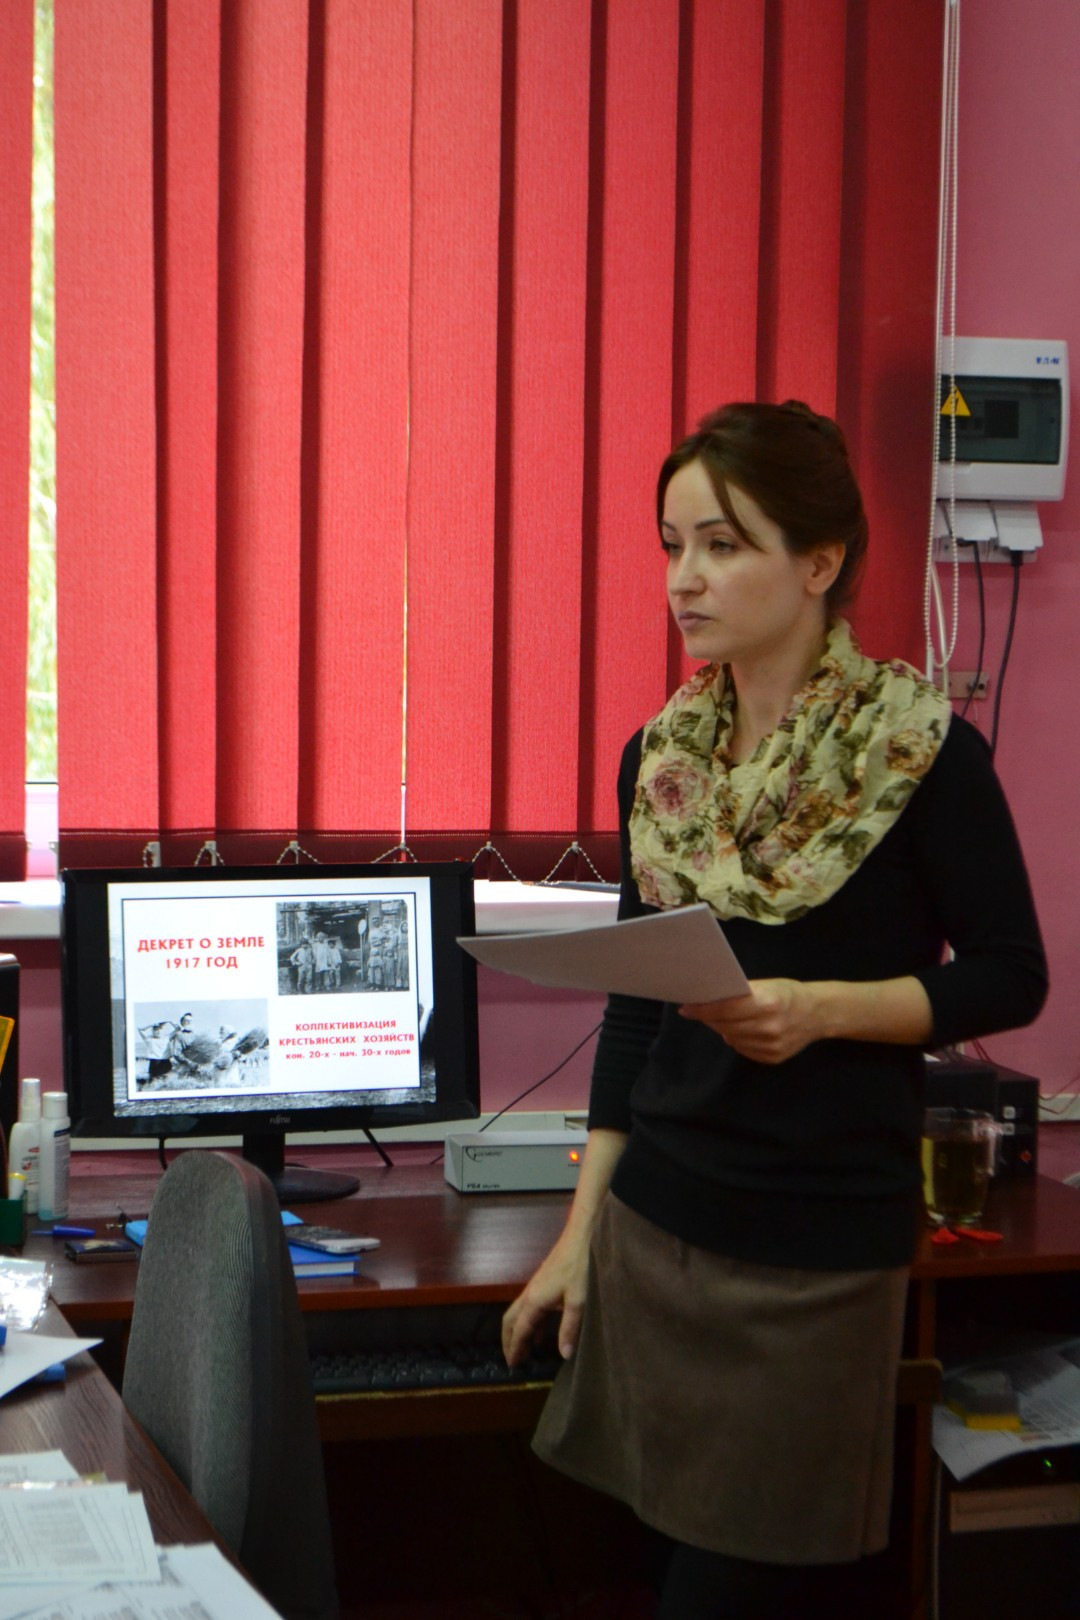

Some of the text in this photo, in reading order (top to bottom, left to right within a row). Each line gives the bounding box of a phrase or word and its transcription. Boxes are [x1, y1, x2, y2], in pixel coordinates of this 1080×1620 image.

[137, 936, 265, 953] ДЕКРЕТ О ЗЕМЛЕ
[166, 956, 238, 969] 1917 ГОД
[295, 1020, 397, 1032] КОЛЛЕКТИВИЗАЦИЯ
[278, 1033, 415, 1047] КРЕСТЬЯНСКИХ ХОЗЯЙСТВ
[309, 1051, 330, 1060] 20-х
[385, 1047, 411, 1057] годов
